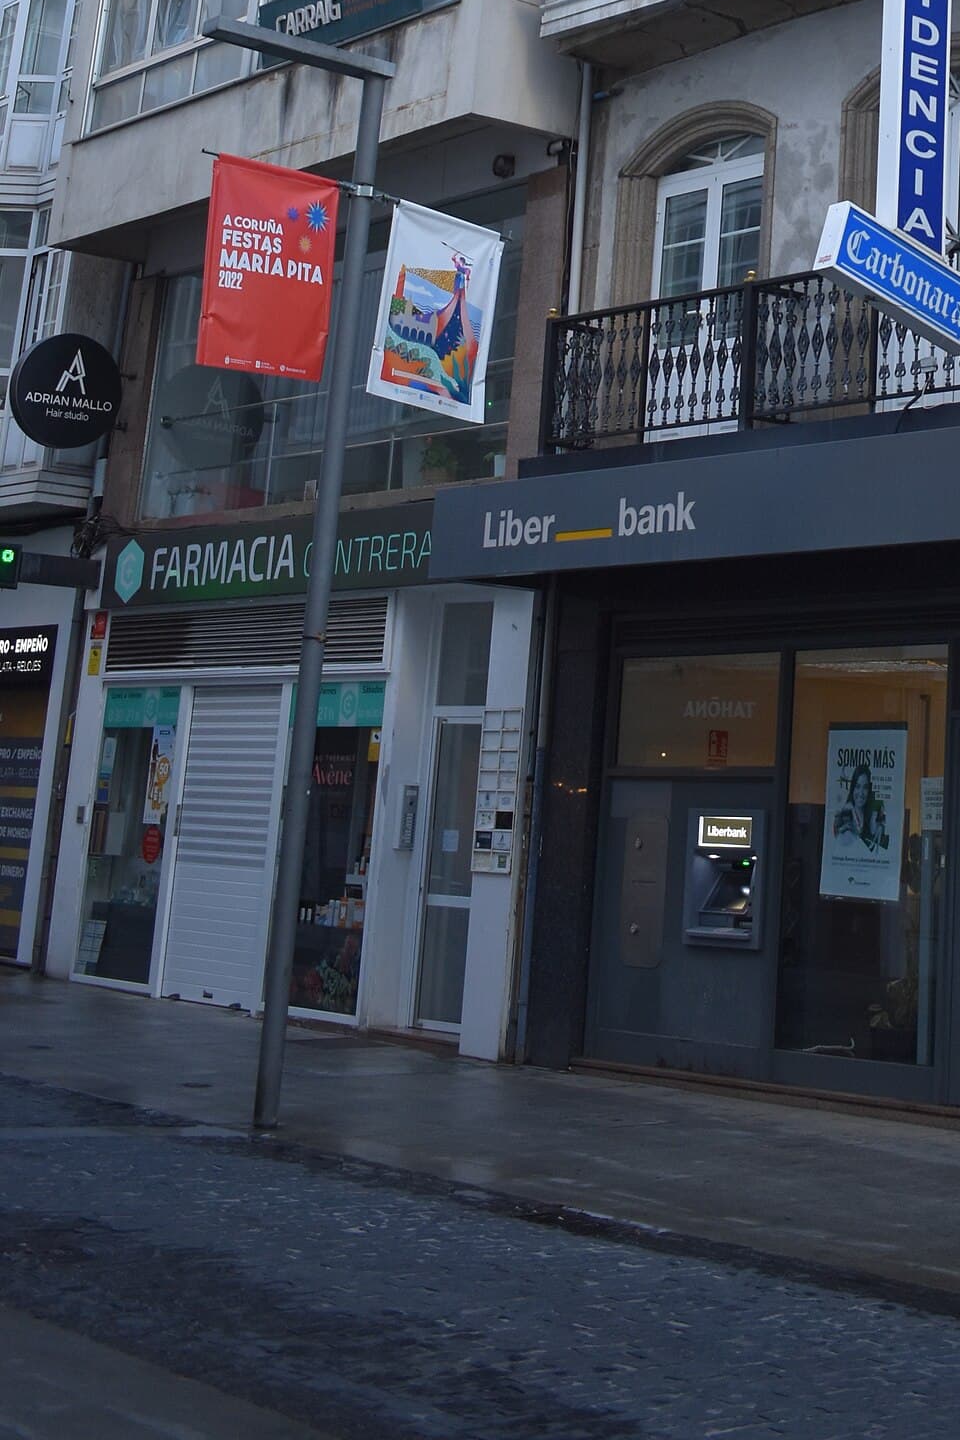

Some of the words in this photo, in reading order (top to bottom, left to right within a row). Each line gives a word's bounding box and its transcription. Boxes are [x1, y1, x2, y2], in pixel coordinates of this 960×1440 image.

[223, 214, 232, 227] A
[234, 216, 284, 235] CORUÑA
[221, 228, 282, 254] FESTAS
[219, 248, 284, 277] MARÍA
[287, 260, 323, 285] PITA
[218, 270, 243, 290] 2022
[25, 391, 70, 407] ADRIAN
[72, 398, 112, 412] MALLO
[46, 407, 63, 418] Hair
[64, 409, 89, 421] studio
[482, 510, 556, 548] Liber
[618, 491, 696, 536] bank
[150, 534, 294, 590] FARMACIA
[303, 530, 432, 577] CNTRERA
[15, 634, 48, 653] EMPEÑO
[837, 748, 871, 768] SOMOS
[873, 746, 895, 769] MÁS
[707, 825, 747, 838] Liberbank
